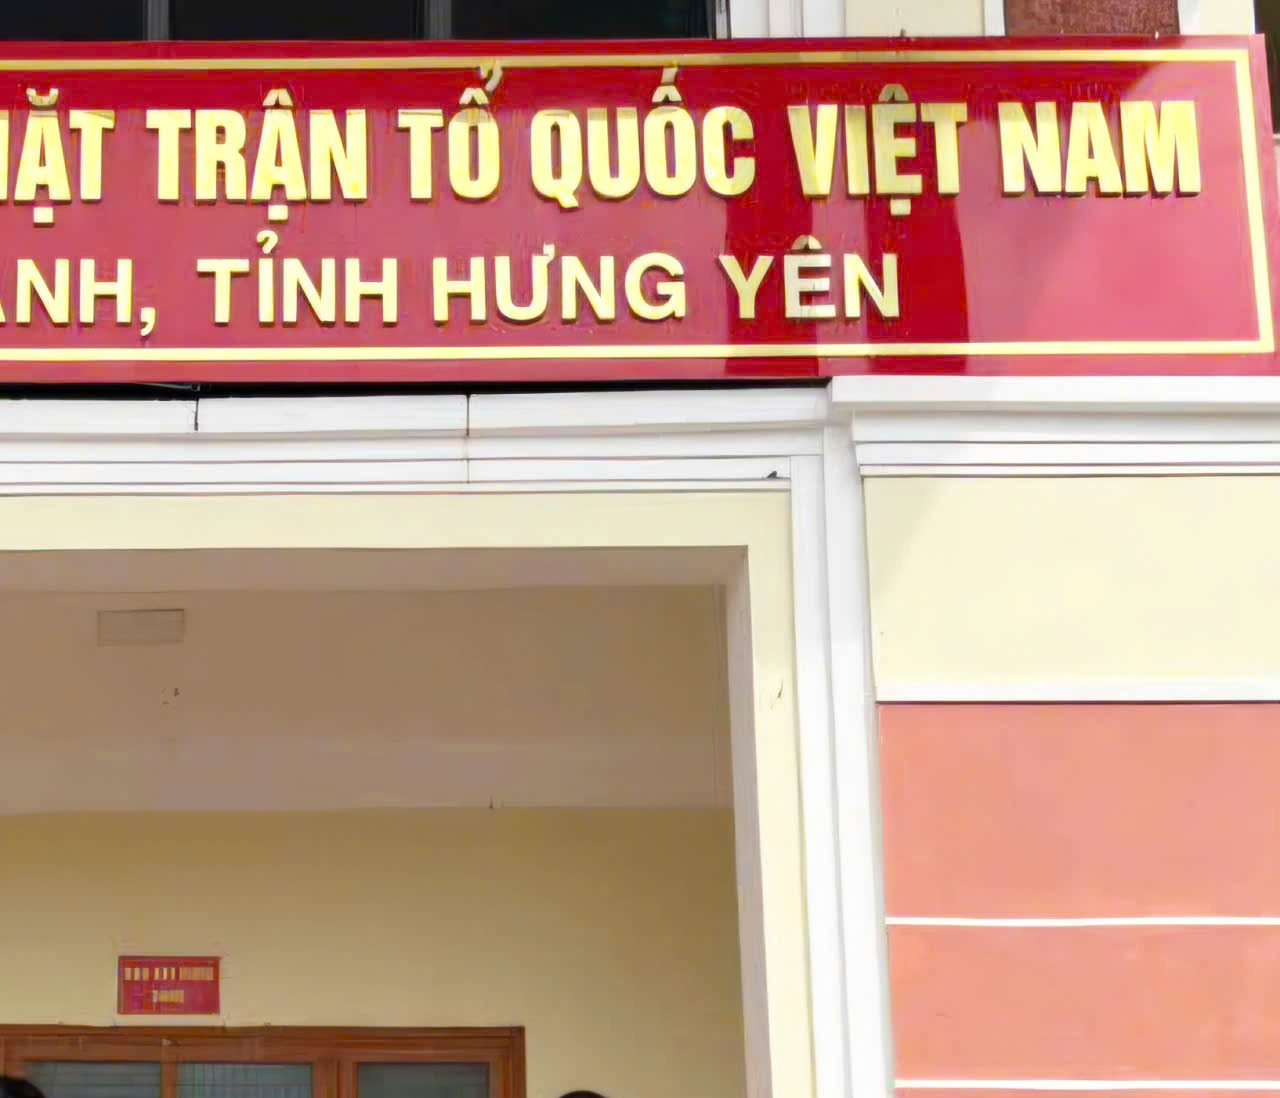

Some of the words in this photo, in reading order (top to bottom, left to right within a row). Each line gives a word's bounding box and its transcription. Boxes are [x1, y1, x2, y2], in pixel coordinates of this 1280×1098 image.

[146, 87, 368, 221] TRẬN
[398, 58, 503, 200] TỔ
[530, 65, 756, 209] QUỐC
[787, 83, 968, 216] VIỆT
[998, 101, 1202, 197] NAM
[196, 230, 399, 325] TỈNH
[432, 243, 687, 324] HƯNG
[718, 234, 901, 320] YÊN
